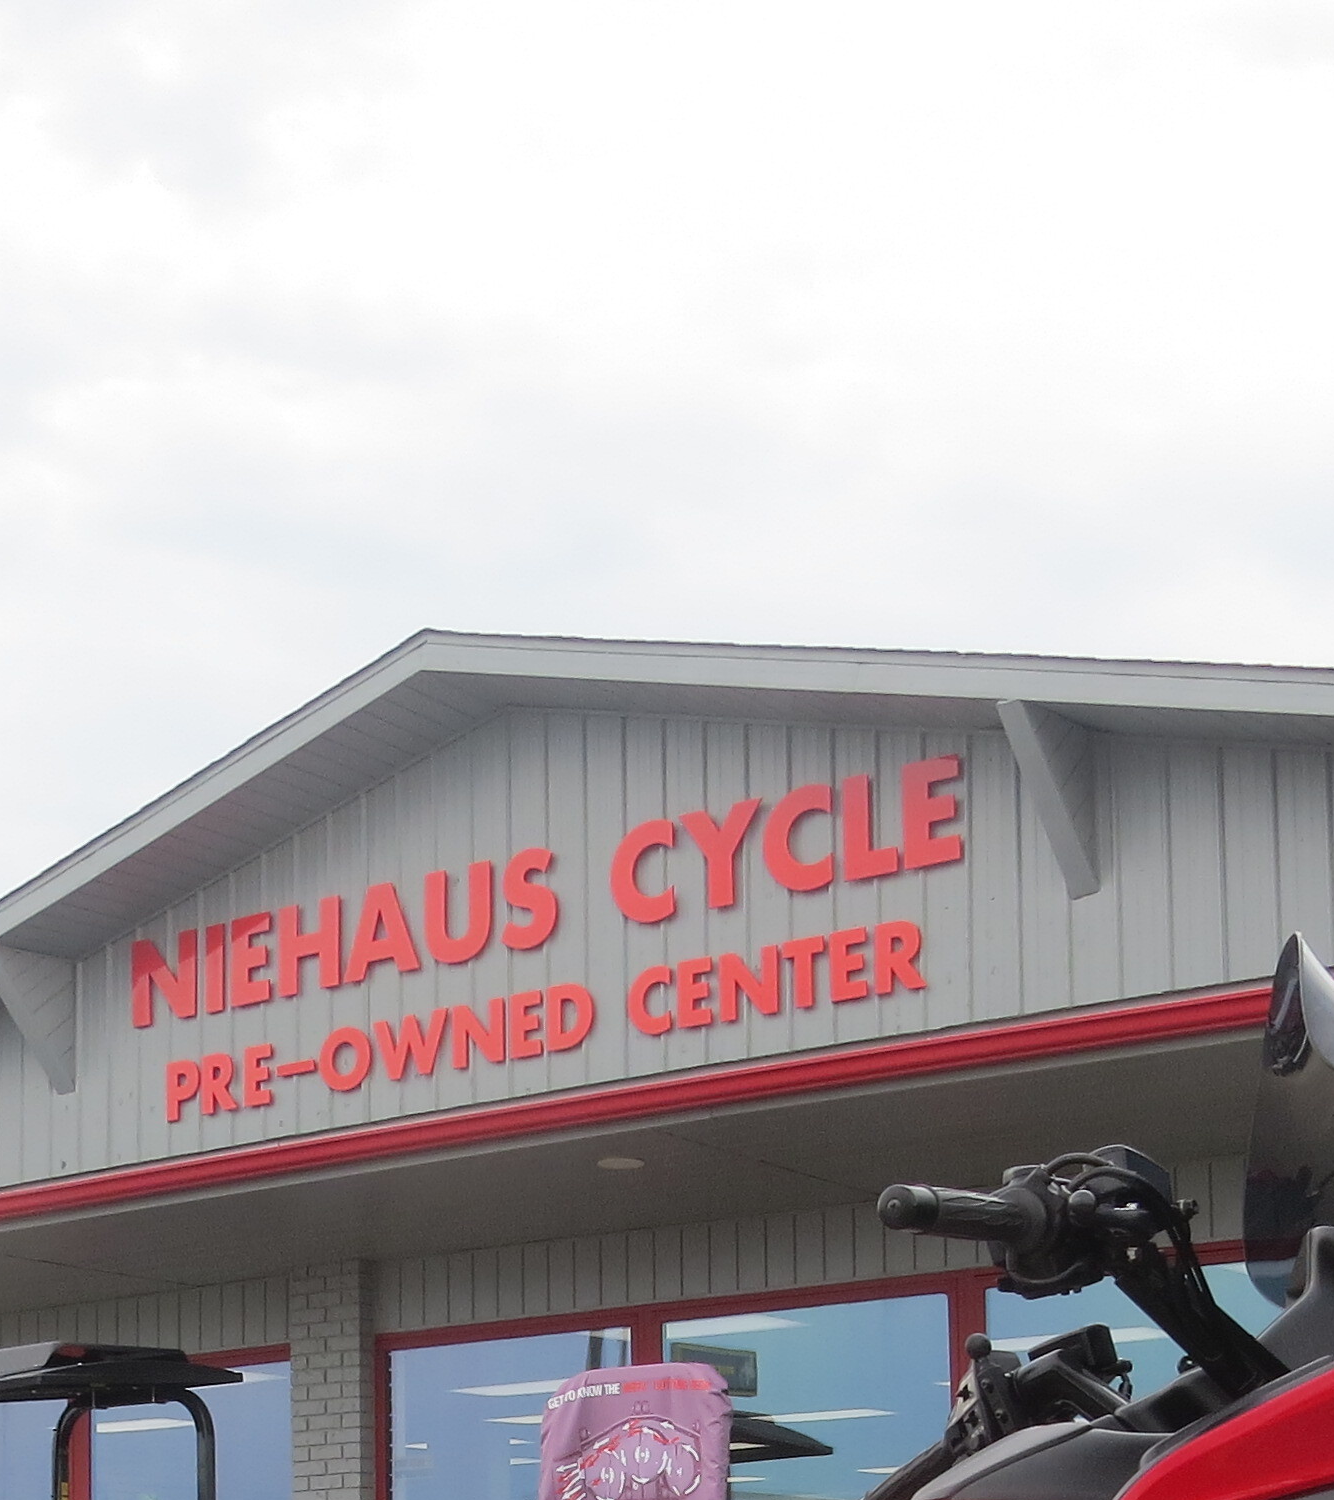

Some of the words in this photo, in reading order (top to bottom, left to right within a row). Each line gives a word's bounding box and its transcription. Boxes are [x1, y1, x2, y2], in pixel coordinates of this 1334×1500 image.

[130, 848, 559, 1028] NIEHAUS
[610, 753, 963, 925] CYCLE
[165, 983, 594, 1123] PRE-OWNED
[627, 919, 927, 1036] CENTER
[547, 1394, 564, 1410] GET
[577, 1384, 603, 1399] KNOW
[604, 1382, 621, 1395] THE
